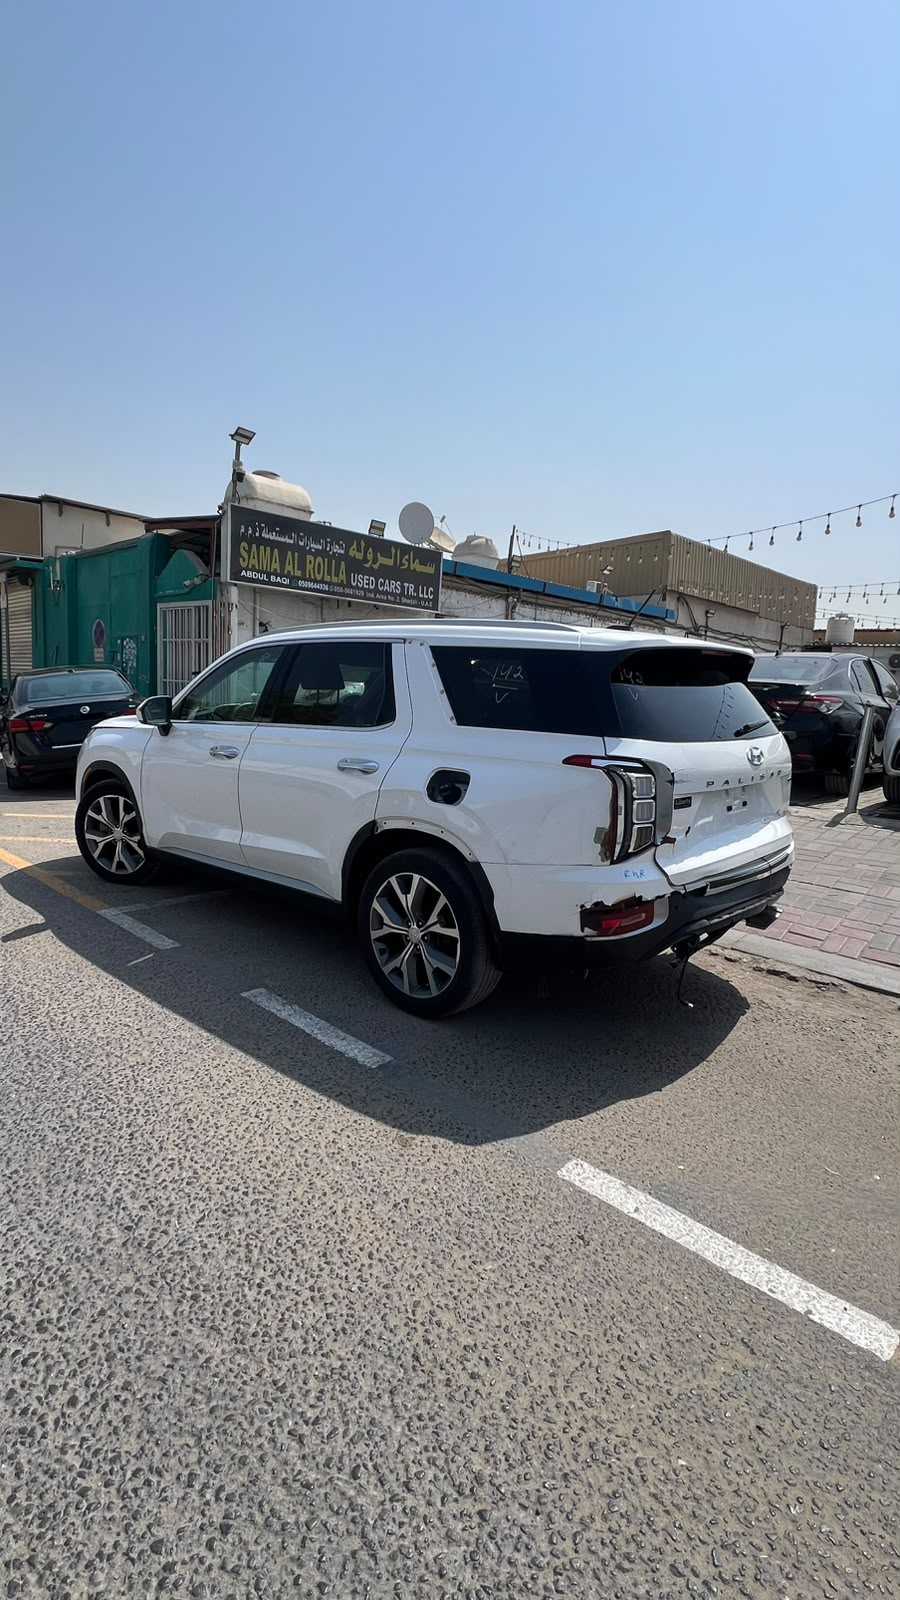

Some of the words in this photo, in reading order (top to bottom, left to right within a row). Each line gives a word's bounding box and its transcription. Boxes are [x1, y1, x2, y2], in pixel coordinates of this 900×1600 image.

[260, 522, 297, 545] المستعملة
[298, 530, 325, 552] السيارات
[239, 541, 280, 573] SAMA
[284, 551, 302, 577] AL
[305, 554, 346, 586] ROLLA
[240, 569, 269, 581] ABDUL
[270, 575, 290, 585] BAQI
[350, 573, 376, 592] USED
[377, 578, 401, 594] CARS
[403, 582, 417, 597] TR.
[418, 585, 434, 599] LLC
